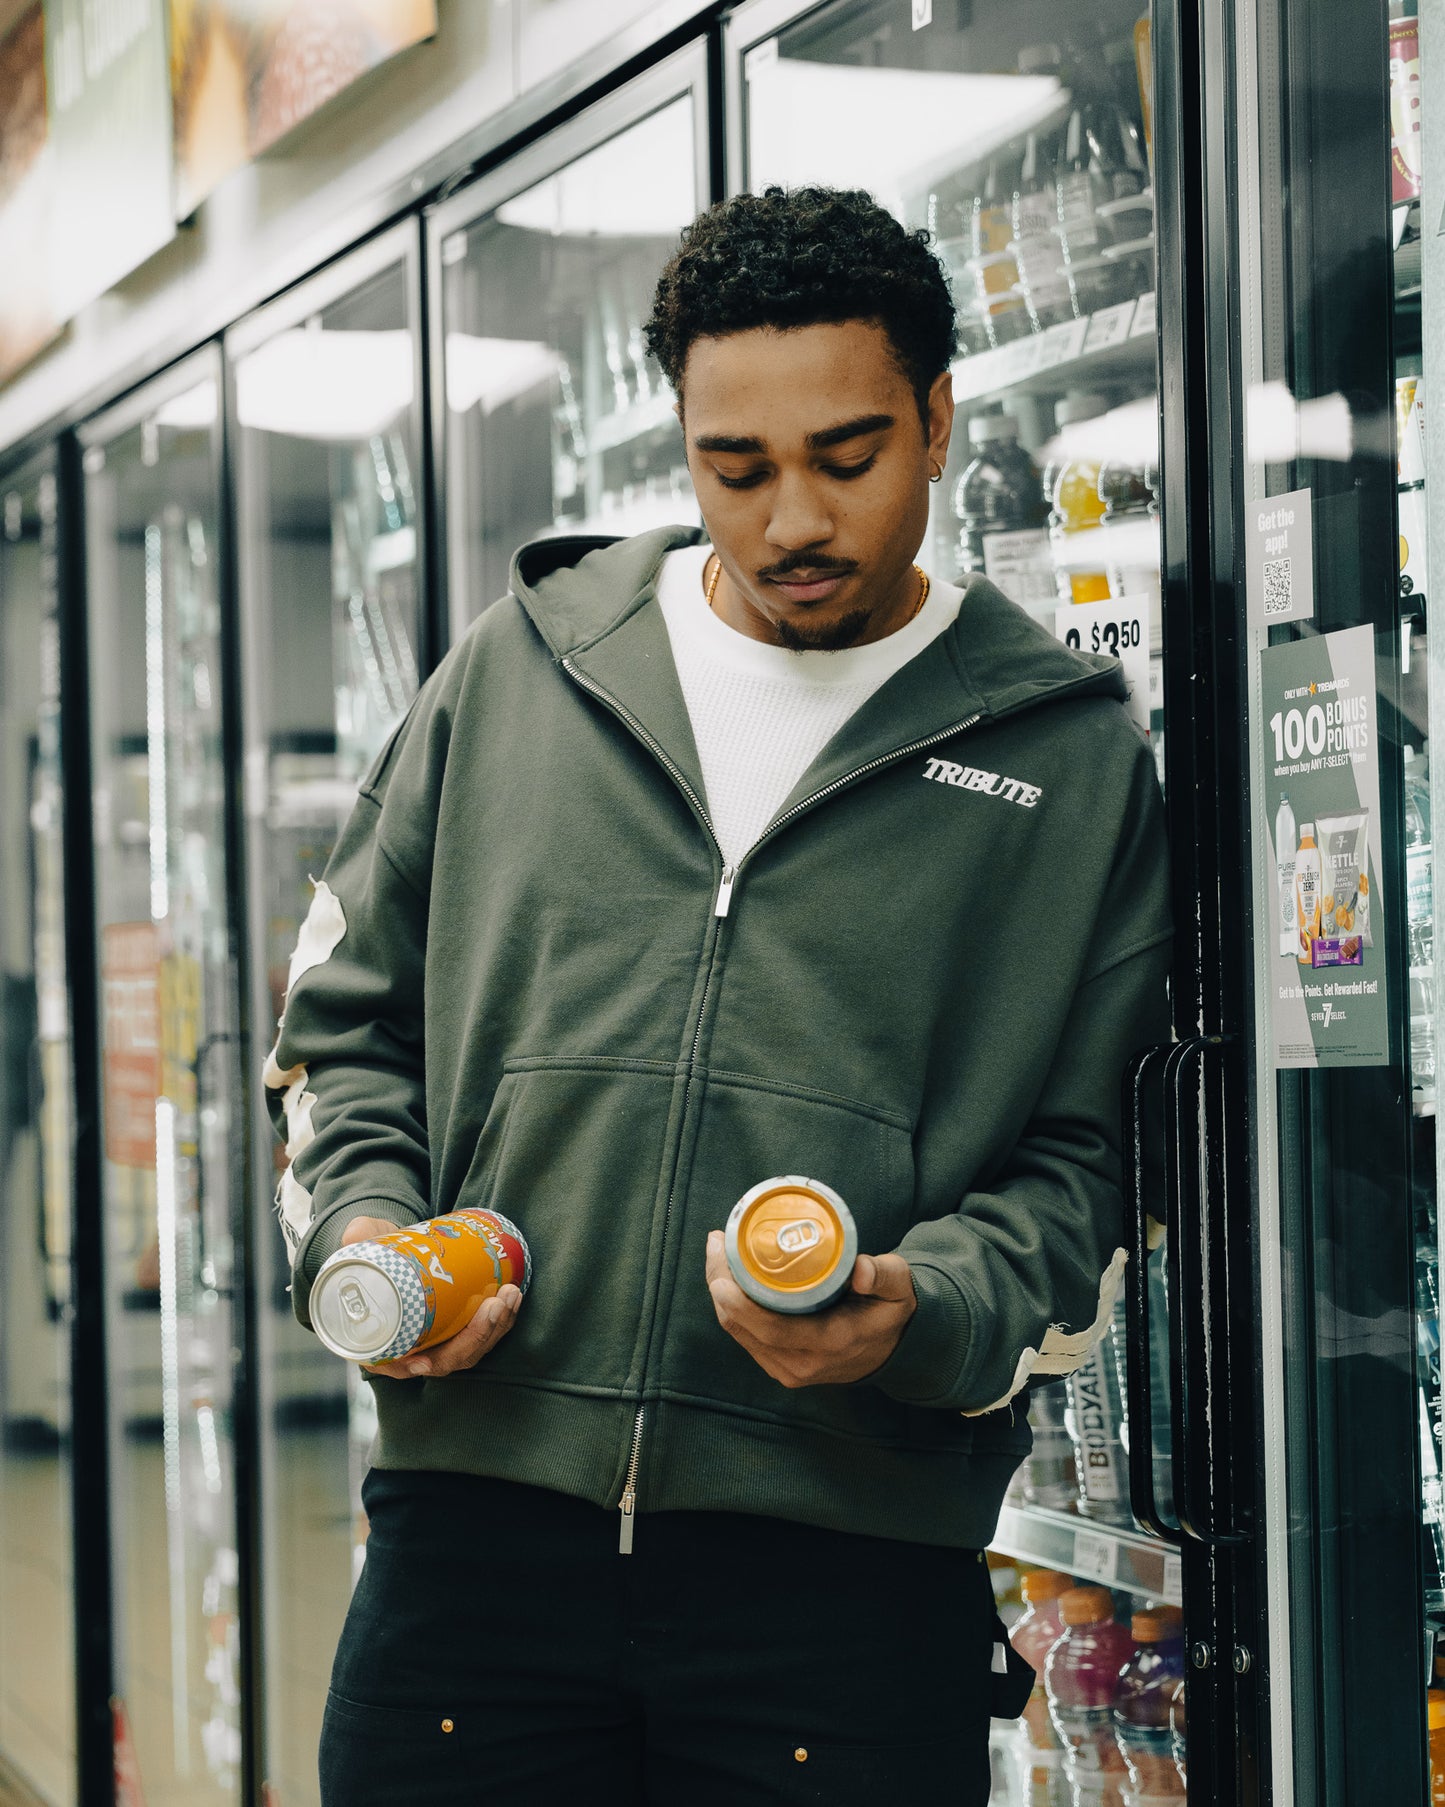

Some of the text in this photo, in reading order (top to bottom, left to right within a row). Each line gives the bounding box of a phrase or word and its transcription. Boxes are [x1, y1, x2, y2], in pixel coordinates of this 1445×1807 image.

[1258, 508, 1295, 532] Get the
[1265, 530, 1288, 555] app!
[1284, 690, 1296, 700] ONLY
[1296, 686, 1308, 698] WITH
[1270, 696, 1367, 761] 100 BONUS
[1327, 722, 1368, 752] POINTS
[1274, 764, 1290, 776] when
[1289, 763, 1300, 776] you
[1300, 760, 1310, 773] buy
[1311, 757, 1323, 770] ANY
[1352, 752, 1367, 763] item
[922, 757, 1042, 808] TRIBUTE
[1278, 862, 1296, 871] PURE
[1326, 852, 1359, 869] KETTLE
[1303, 882, 1315, 892] ZERO
[1279, 980, 1378, 999] Get to the Points. Get Rewarded Fast!
[1311, 1013, 1324, 1021] SEVEN
[1322, 1003, 1332, 1027] 7
[1078, 1355, 1109, 1467] BODYAR
